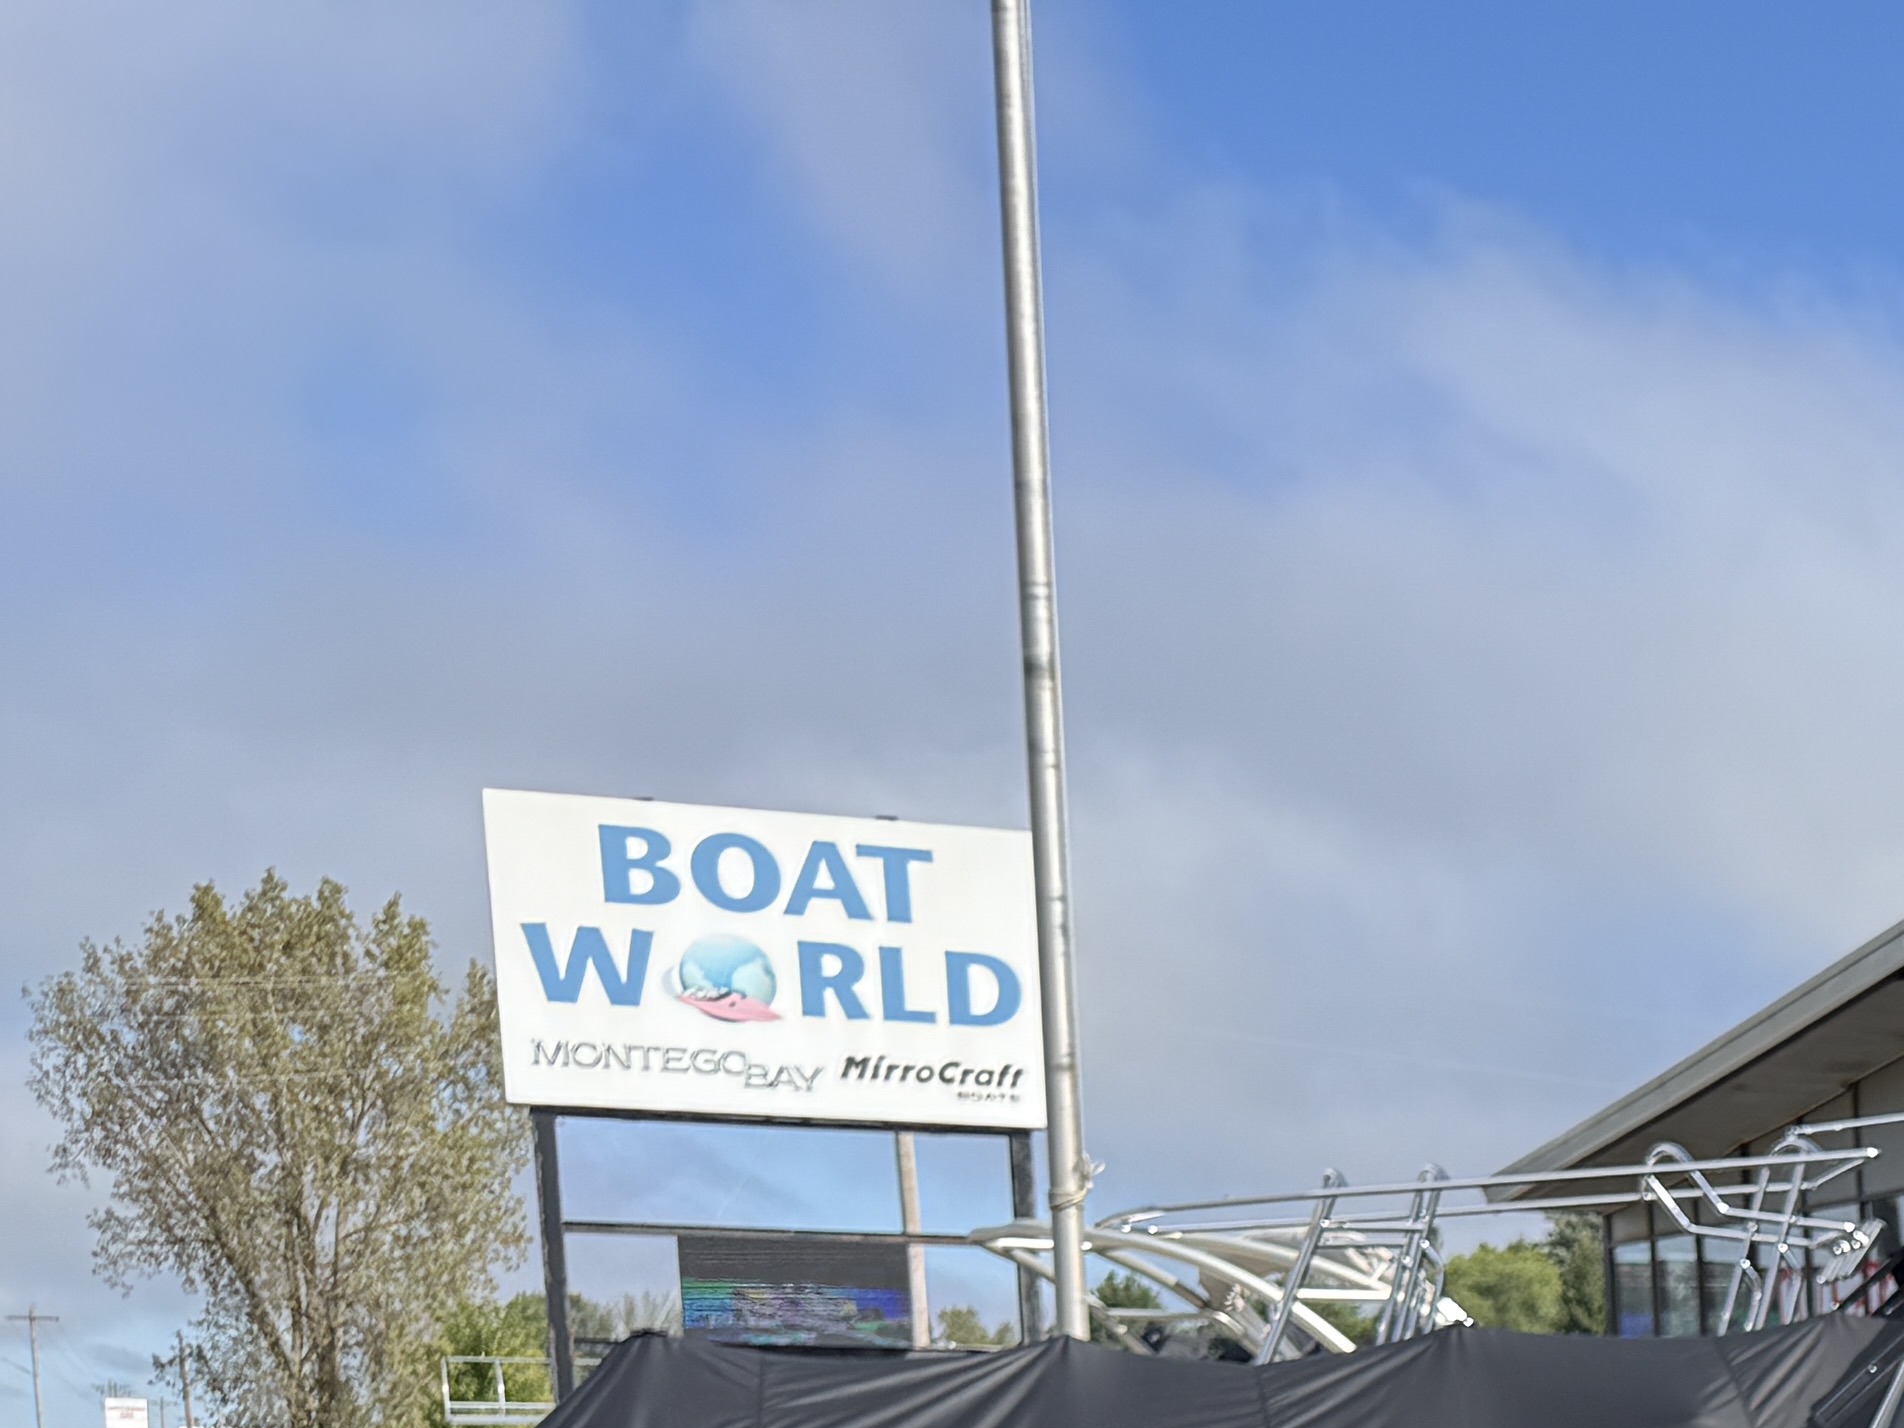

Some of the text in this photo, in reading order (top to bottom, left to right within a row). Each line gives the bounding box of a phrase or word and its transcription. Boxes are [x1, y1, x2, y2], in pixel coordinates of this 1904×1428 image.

[597, 823, 933, 924] BOAT
[530, 1038, 825, 1092] MONTEGO BAY
[841, 1055, 1024, 1088] MirroCraft
